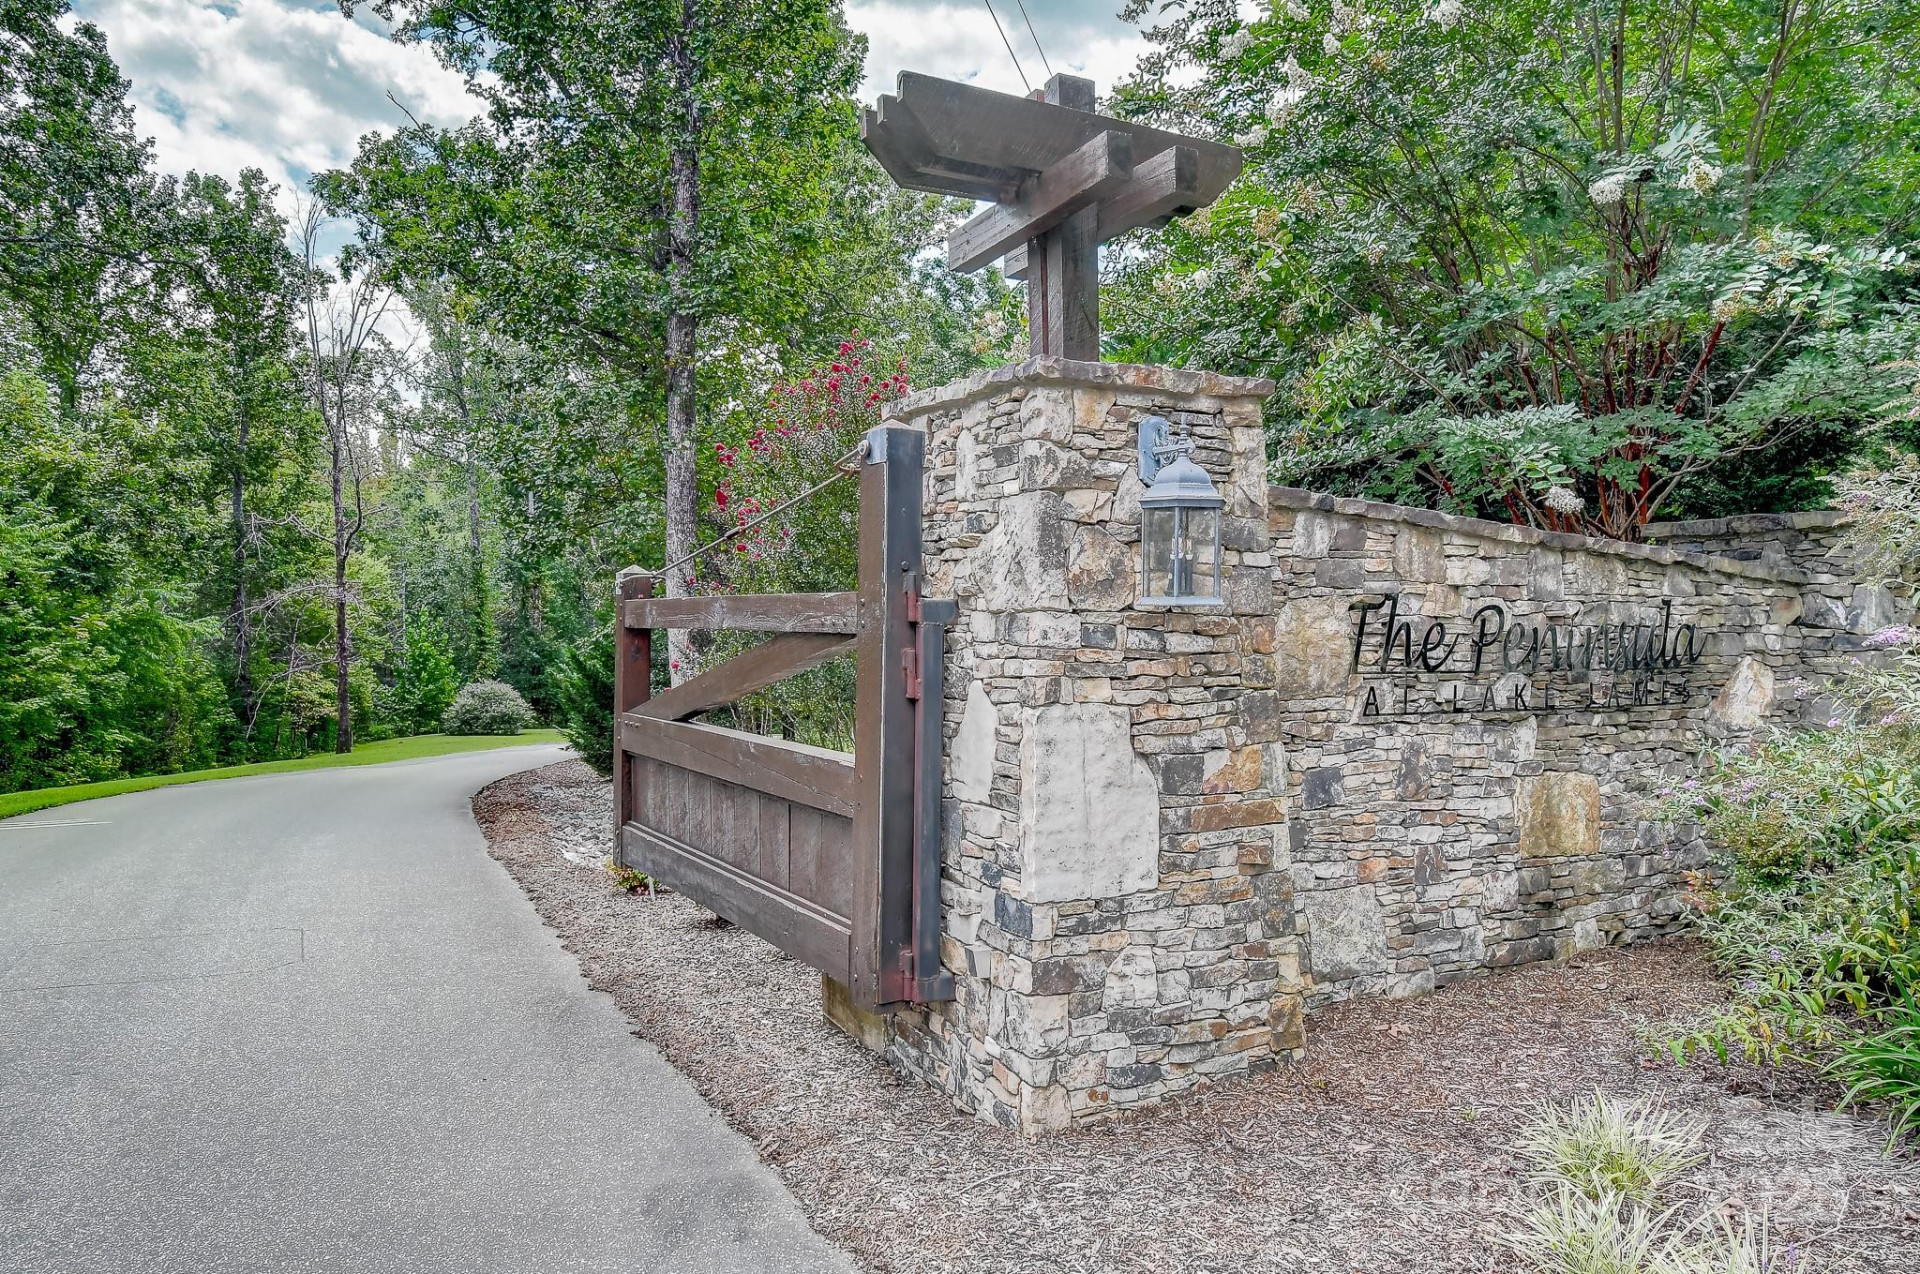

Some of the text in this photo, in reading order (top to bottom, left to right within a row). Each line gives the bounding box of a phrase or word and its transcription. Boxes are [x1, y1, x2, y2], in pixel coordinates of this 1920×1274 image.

[1348, 593, 1708, 676] The Peninsula
[1585, 678, 1691, 709] JAMES
